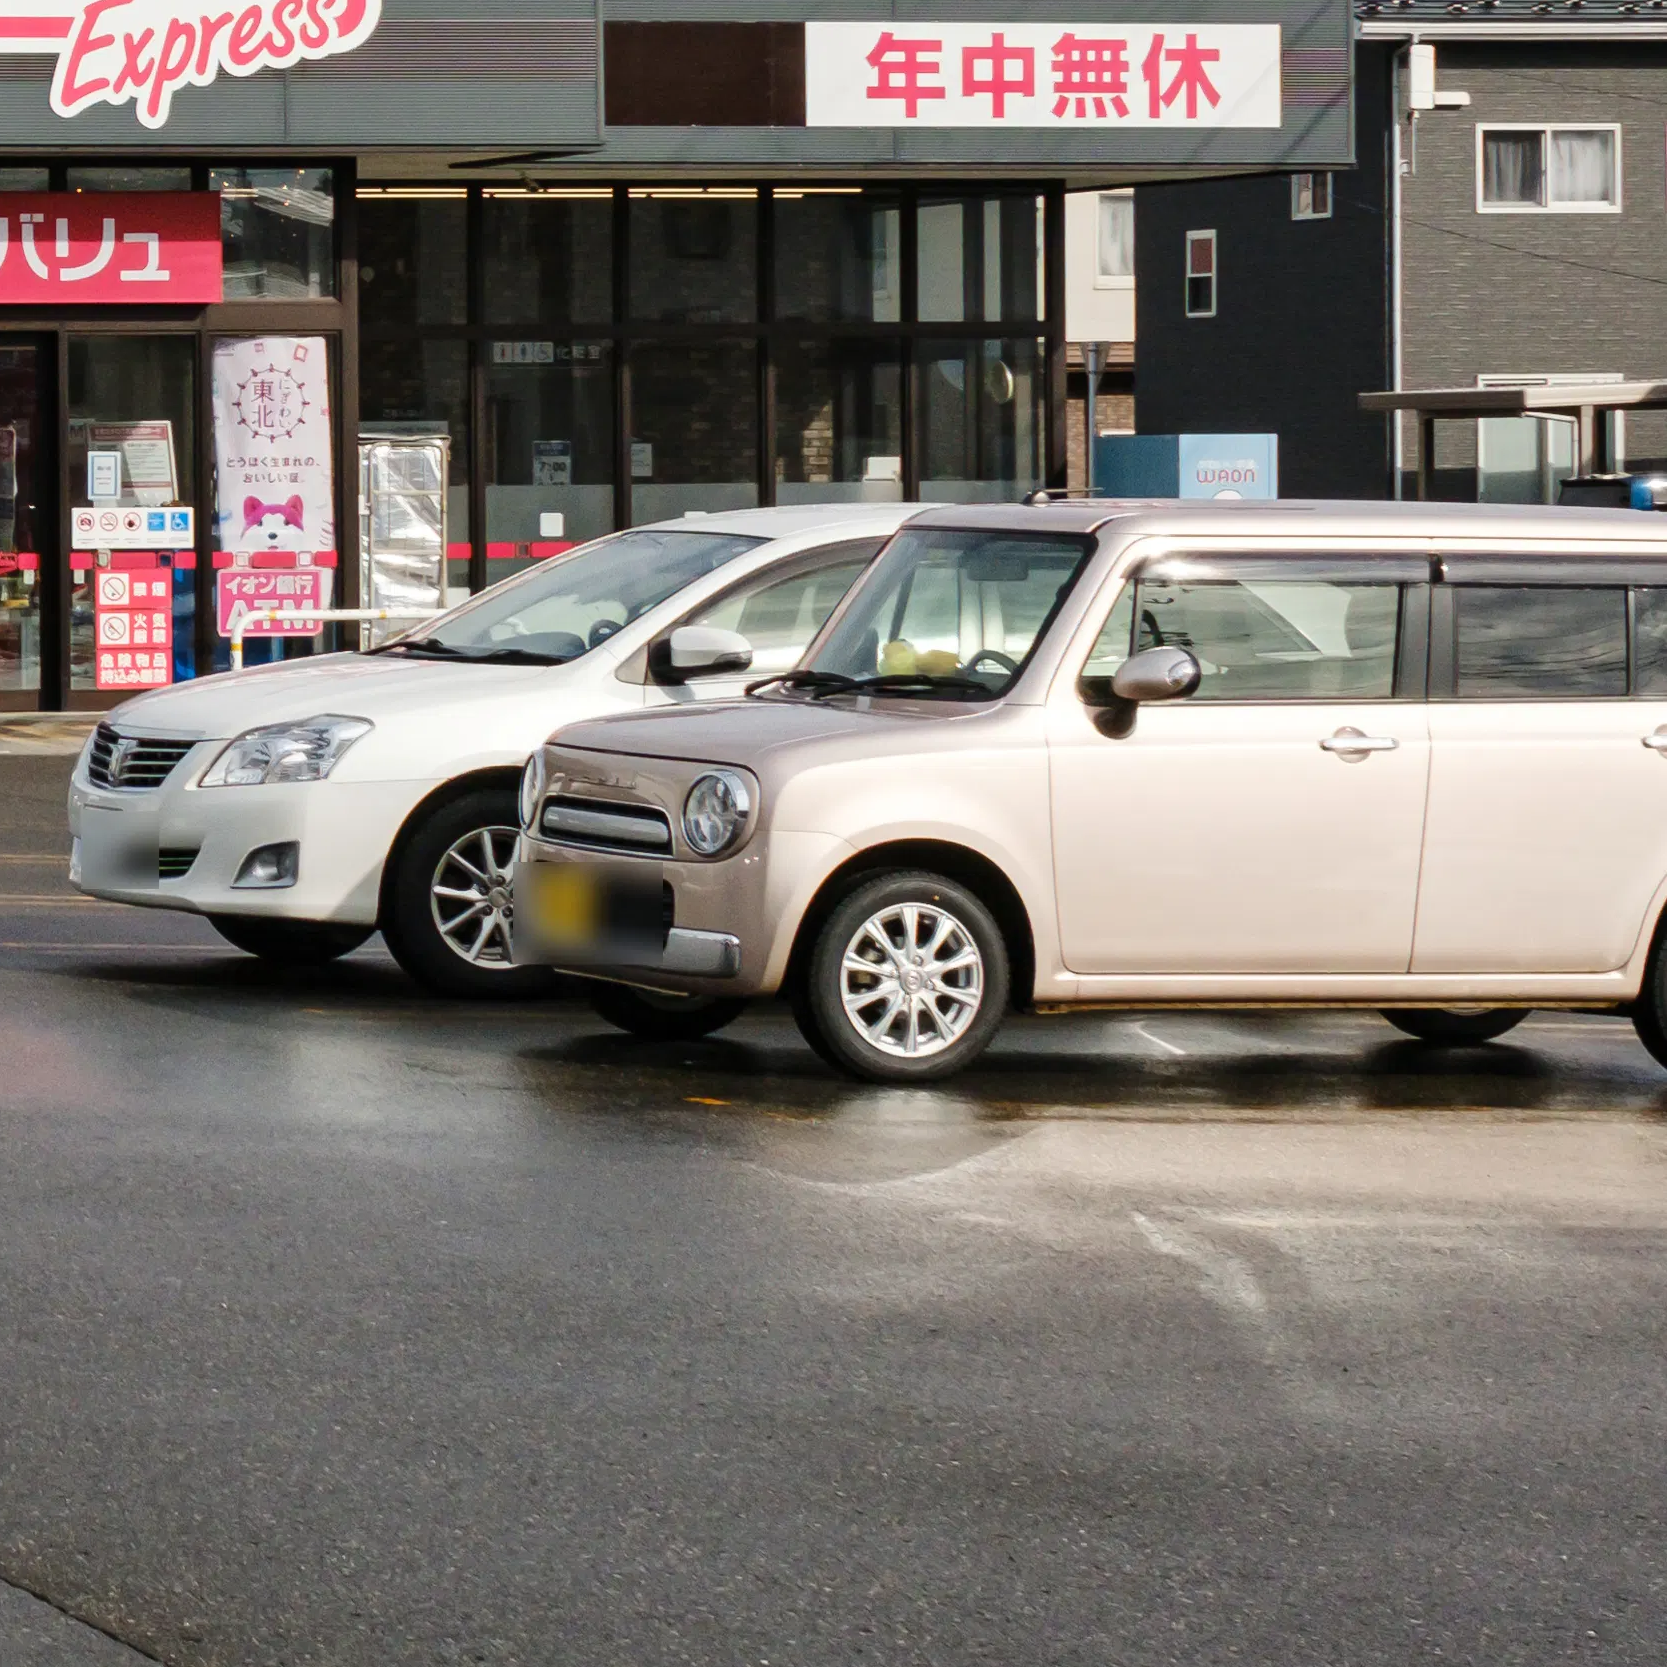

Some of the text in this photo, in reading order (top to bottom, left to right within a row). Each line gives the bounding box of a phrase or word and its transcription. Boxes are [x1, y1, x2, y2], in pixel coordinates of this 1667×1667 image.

[865, 32, 1222, 119] 年中無休
[251, 379, 275, 428] 東北
[225, 599, 314, 630] ATM
